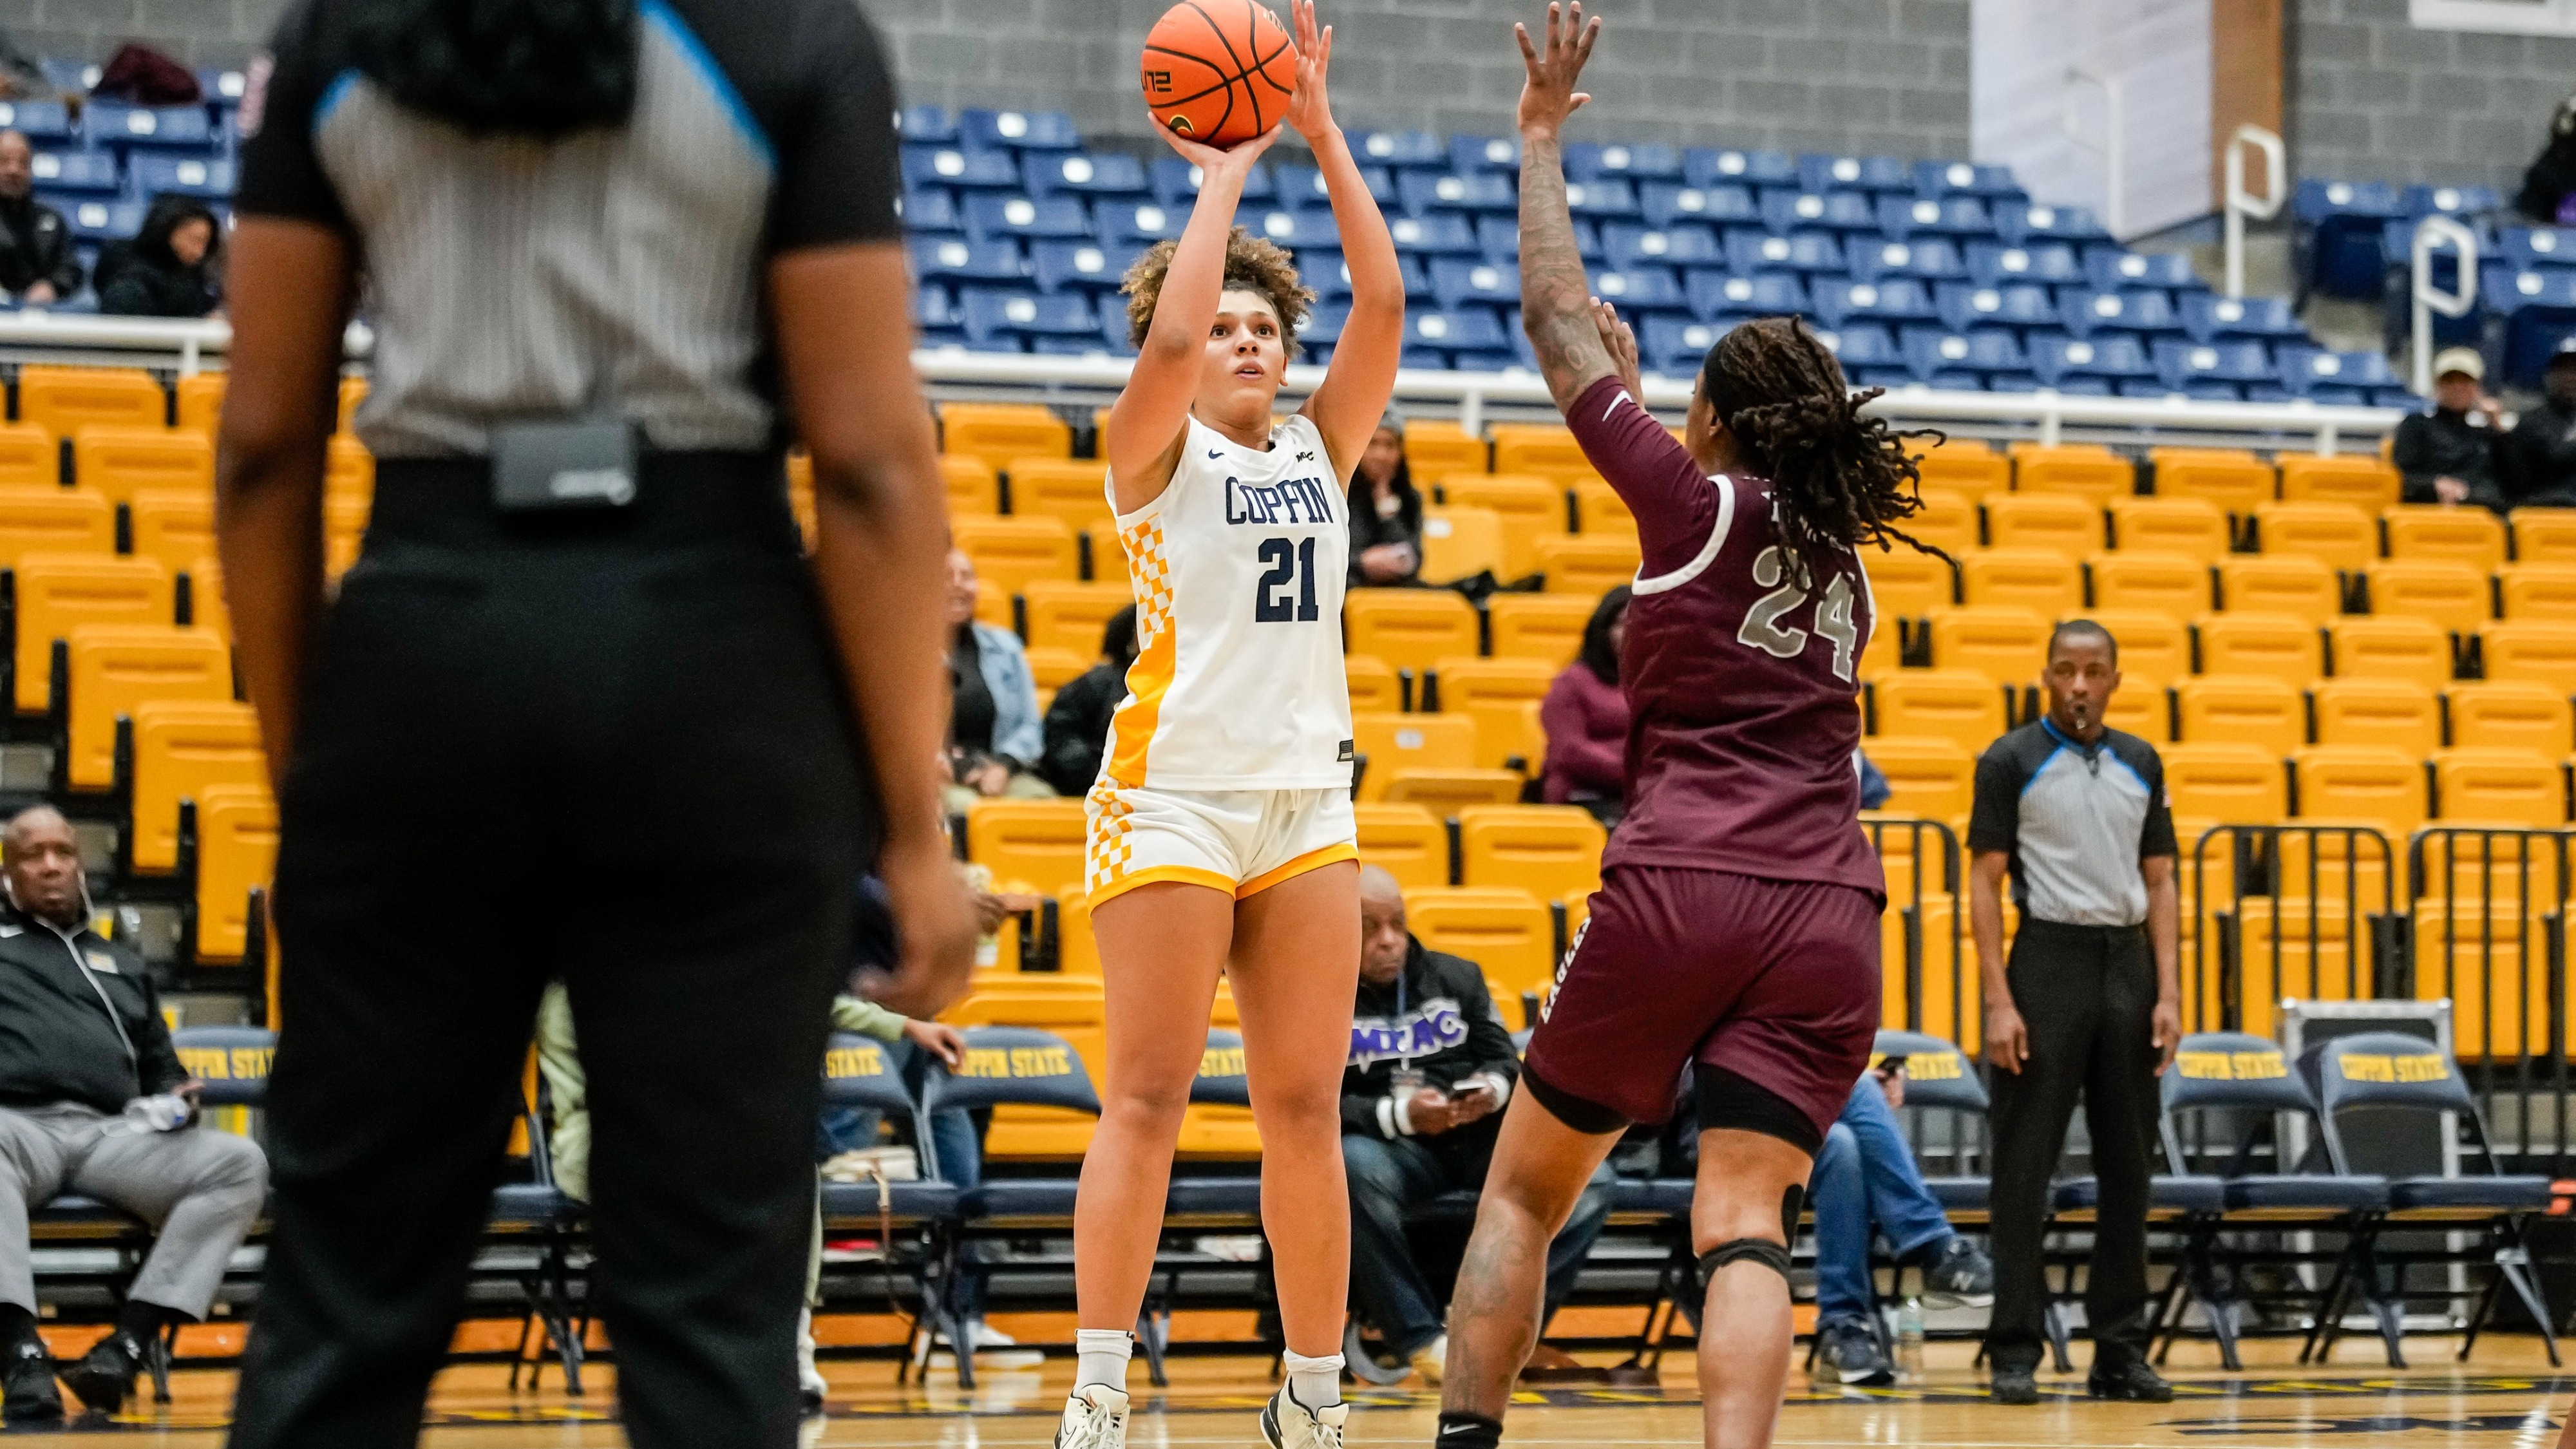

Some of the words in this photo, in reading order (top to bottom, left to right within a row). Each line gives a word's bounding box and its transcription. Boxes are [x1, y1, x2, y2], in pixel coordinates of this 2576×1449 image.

[1225, 476, 1334, 526] COPPIN
[1255, 536, 1318, 623] 21
[1737, 545, 1857, 683] 24
[826, 1047, 883, 1078] STATE
[1010, 1046, 1070, 1077] STATE
[1199, 1048, 1246, 1077] STAT
[2233, 1052, 2287, 1080] STATE
[2394, 1052, 2449, 1083] STATE
